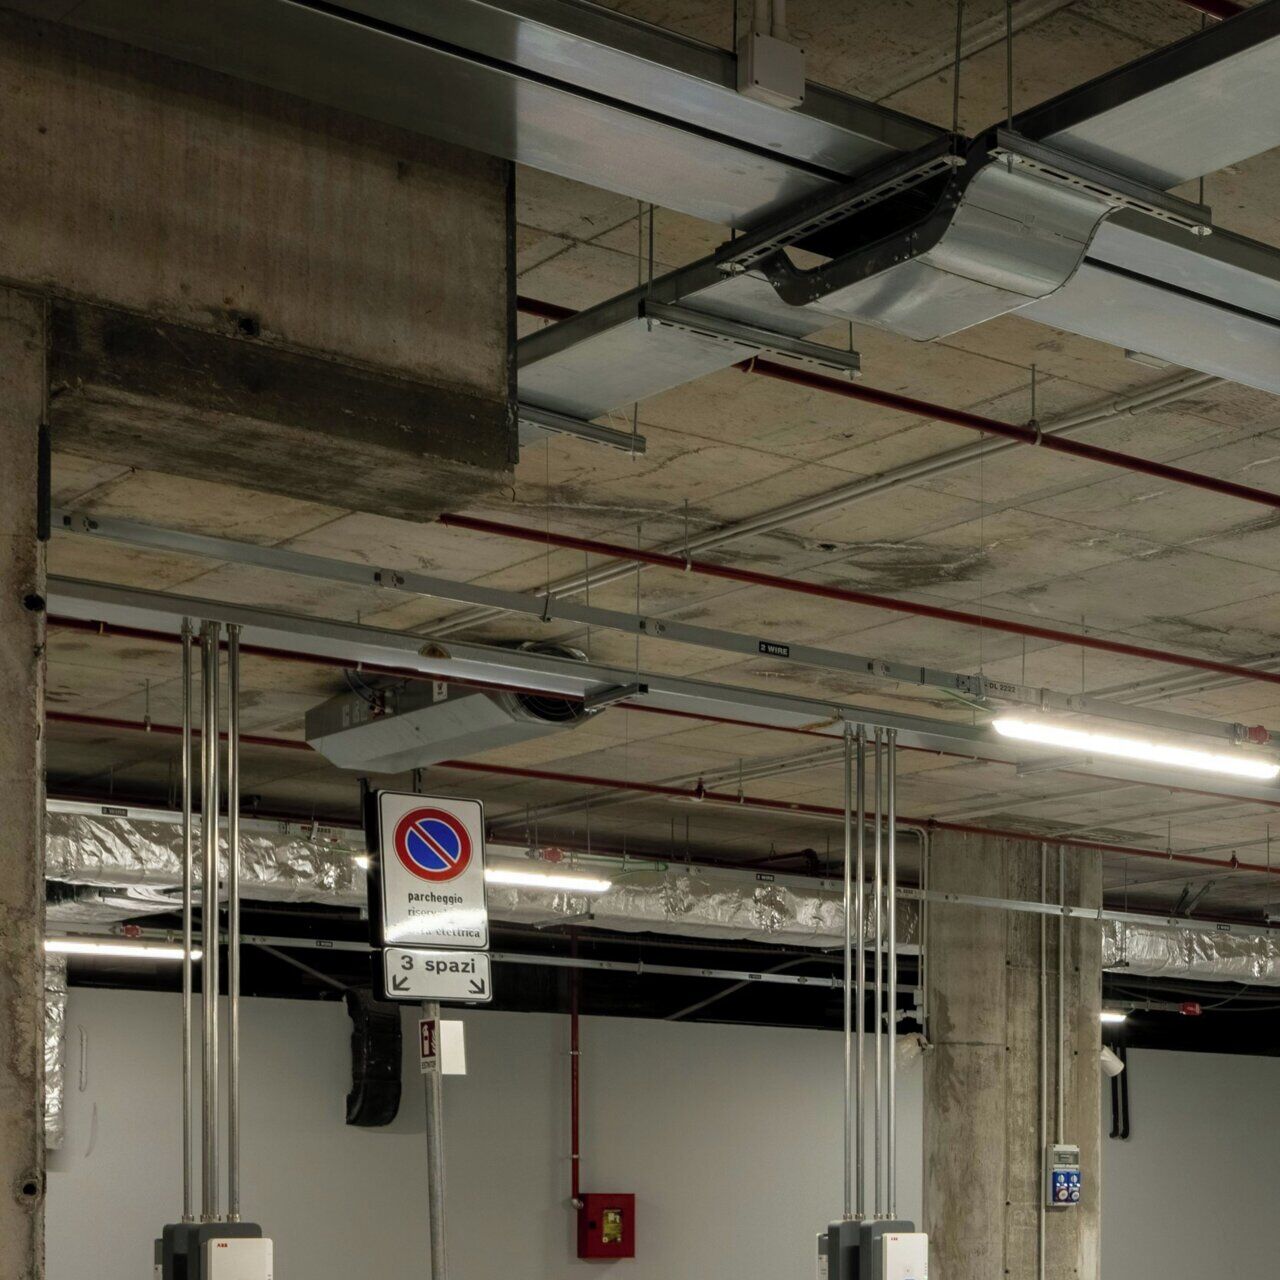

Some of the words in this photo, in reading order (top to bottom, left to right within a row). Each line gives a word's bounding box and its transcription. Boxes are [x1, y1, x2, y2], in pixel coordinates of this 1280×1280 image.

[760, 643, 766, 651] 2
[768, 645, 788, 656] WIRE
[408, 892, 463, 905] parcheggio
[401, 955, 414, 970] 3
[425, 958, 475, 975] spazi
